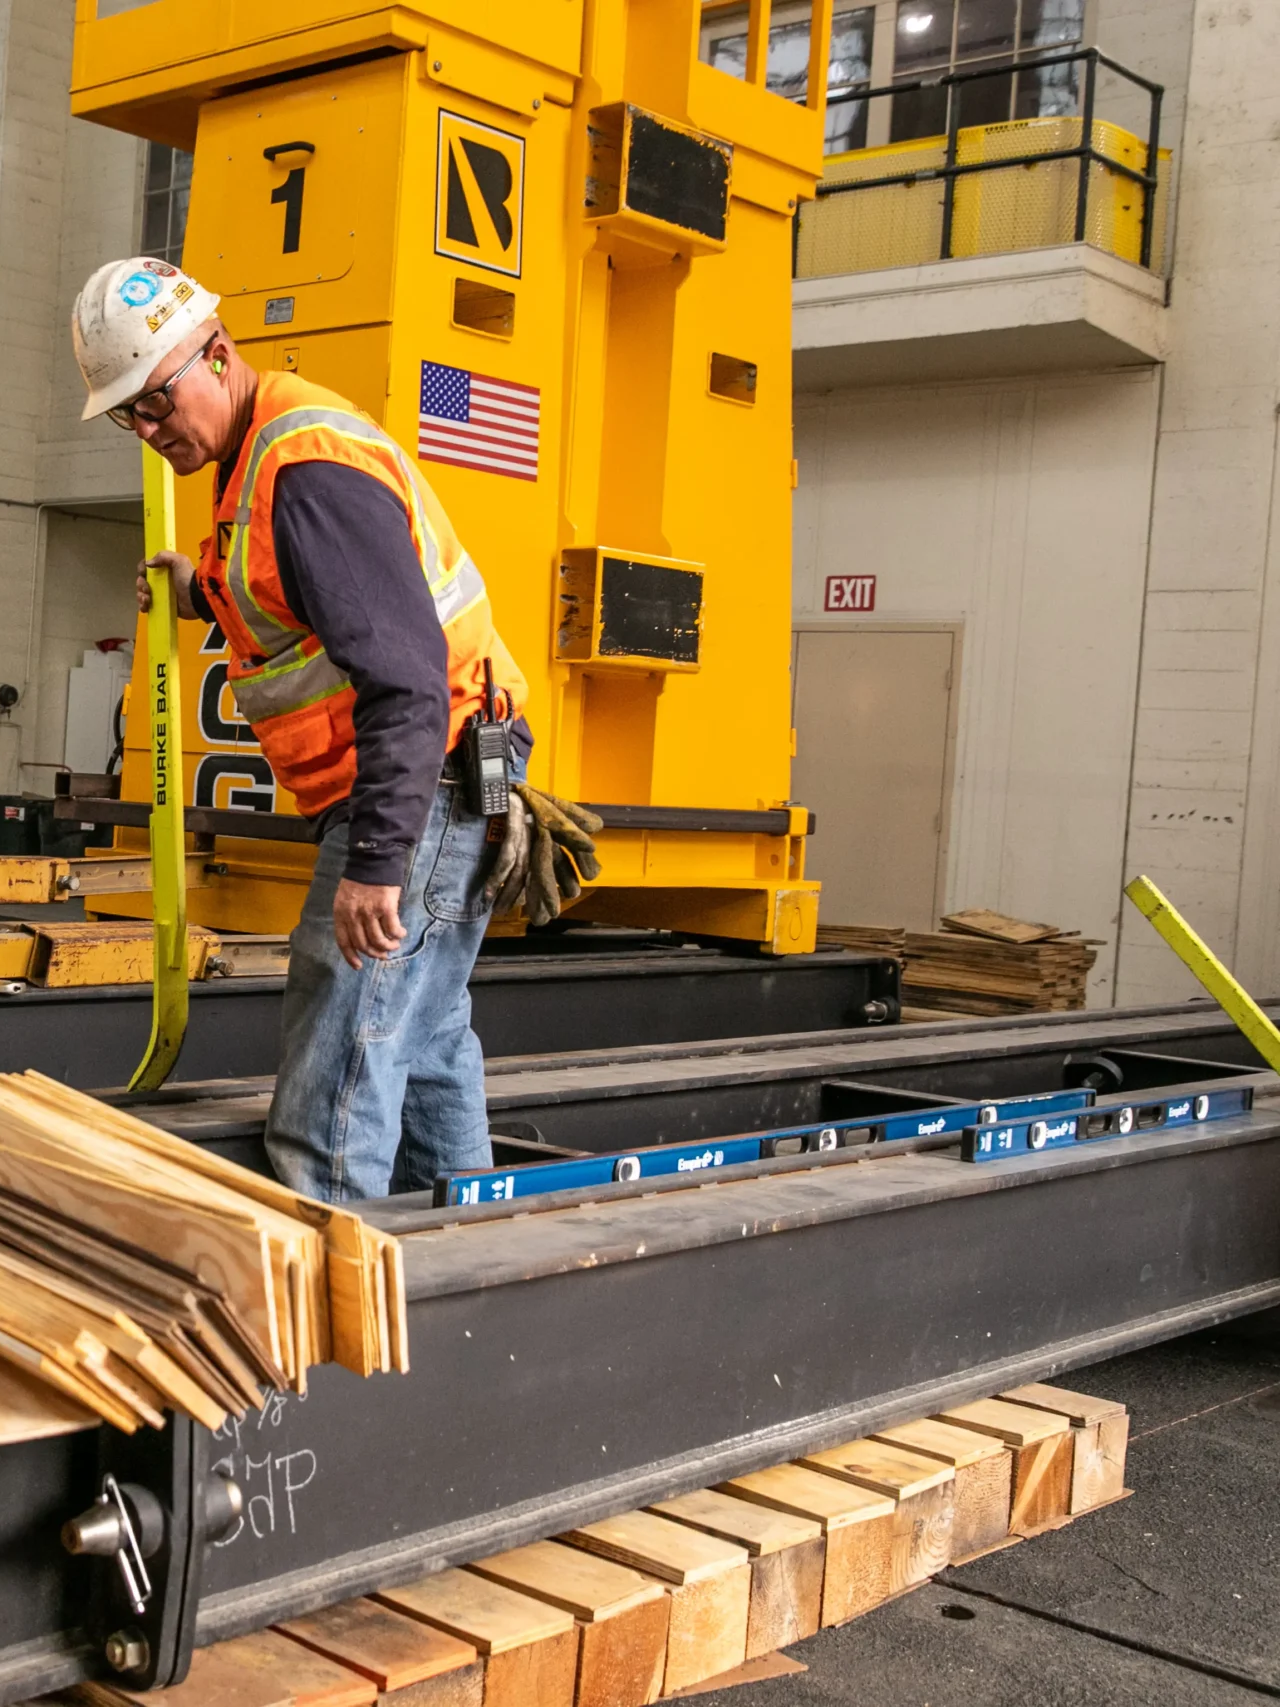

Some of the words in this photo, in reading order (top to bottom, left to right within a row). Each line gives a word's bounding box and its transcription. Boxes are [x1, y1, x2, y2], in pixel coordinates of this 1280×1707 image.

[271, 167, 305, 254] 1
[828, 578, 874, 608] EXIT
[156, 663, 167, 713] BAR
[156, 723, 167, 806] BURKE
[918, 1117, 946, 1135] Empire
[677, 1150, 713, 1171] Empire
